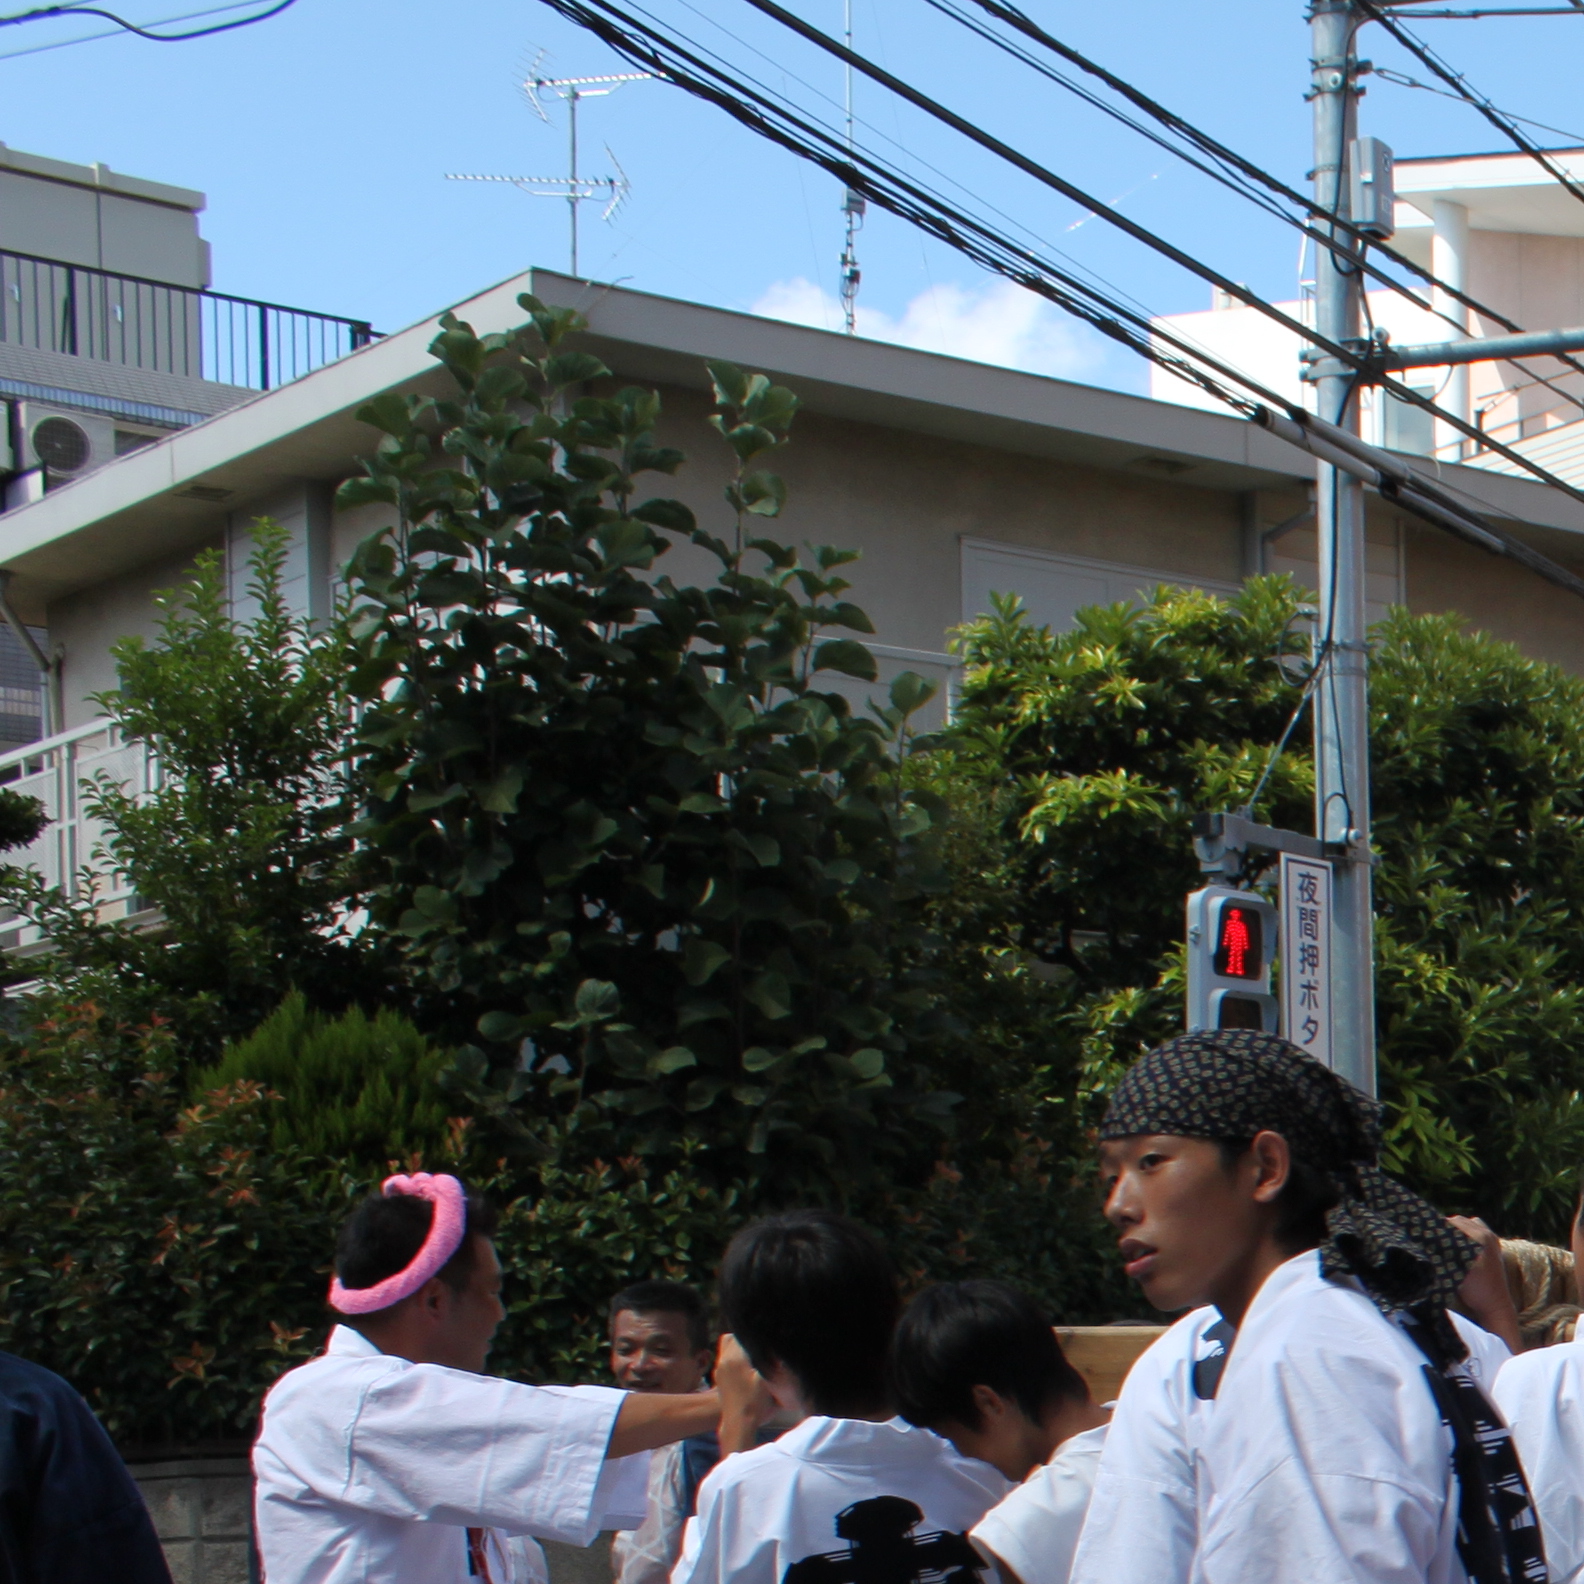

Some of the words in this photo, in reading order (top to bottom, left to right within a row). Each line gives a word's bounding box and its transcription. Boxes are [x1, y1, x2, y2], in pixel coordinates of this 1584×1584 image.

[1297, 871, 1320, 1046] 夜間押ボタ
